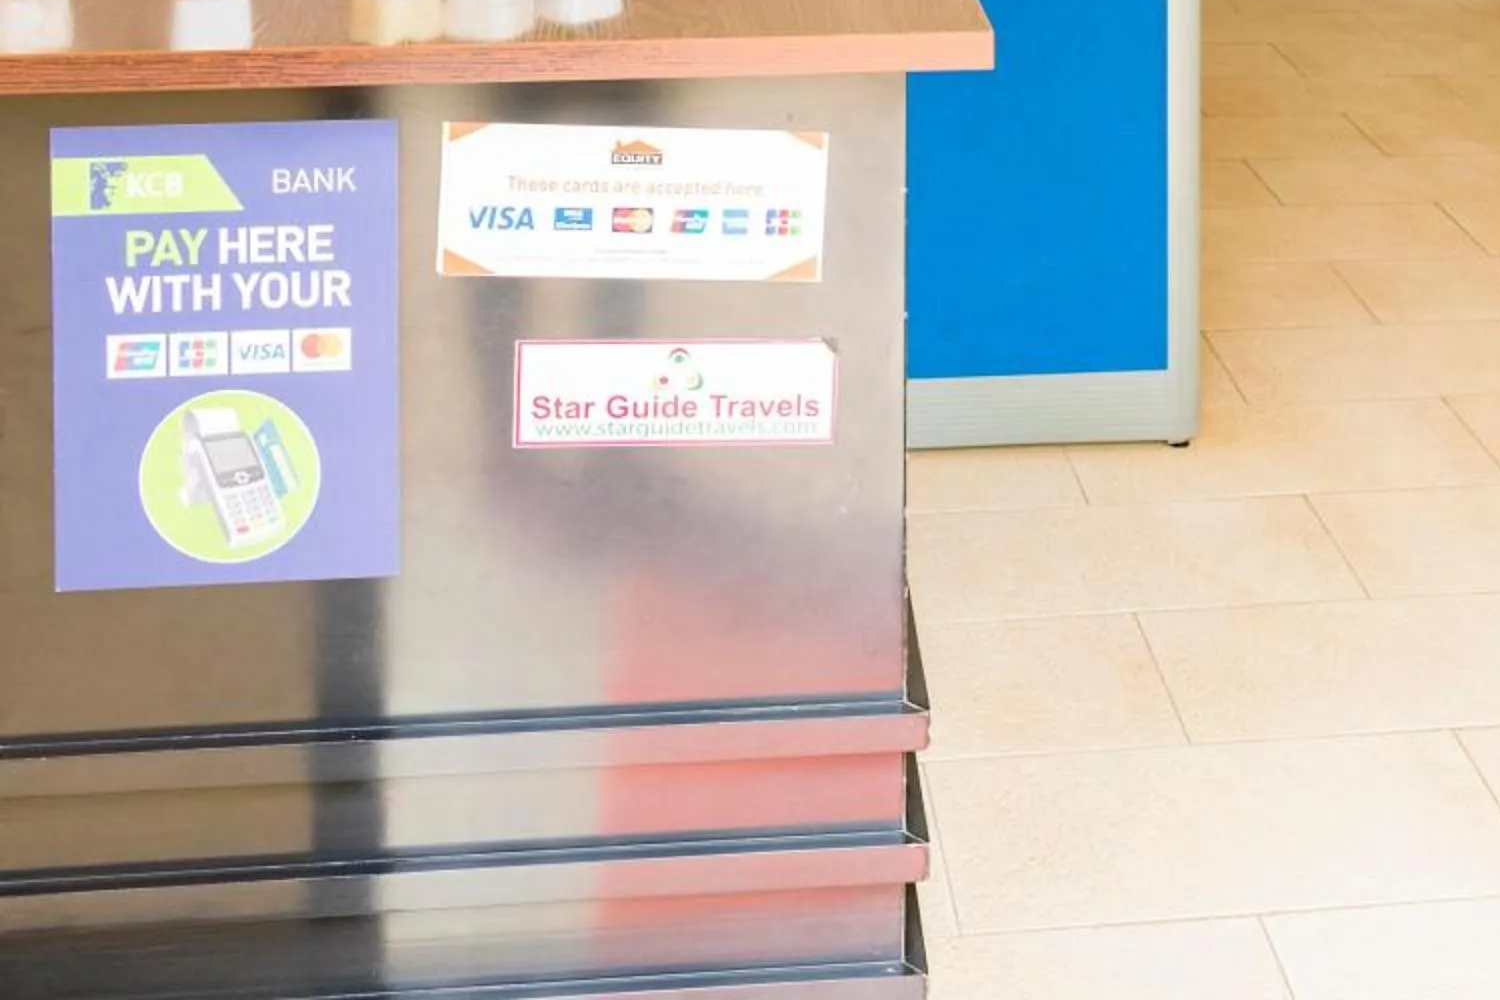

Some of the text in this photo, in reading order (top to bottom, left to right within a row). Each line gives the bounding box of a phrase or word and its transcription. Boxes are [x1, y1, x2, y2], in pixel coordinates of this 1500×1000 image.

[126, 171, 184, 197] KCB
[272, 167, 357, 193] BANK
[507, 175, 764, 198] These cards are accepted here
[468, 206, 535, 231] VISA
[125, 225, 335, 267] PAY HERE
[105, 270, 352, 314] WITH YOUR
[239, 343, 285, 361] VISA
[531, 394, 820, 420] Star Guide Travels
[534, 418, 818, 439] www.starguidetravels.com
